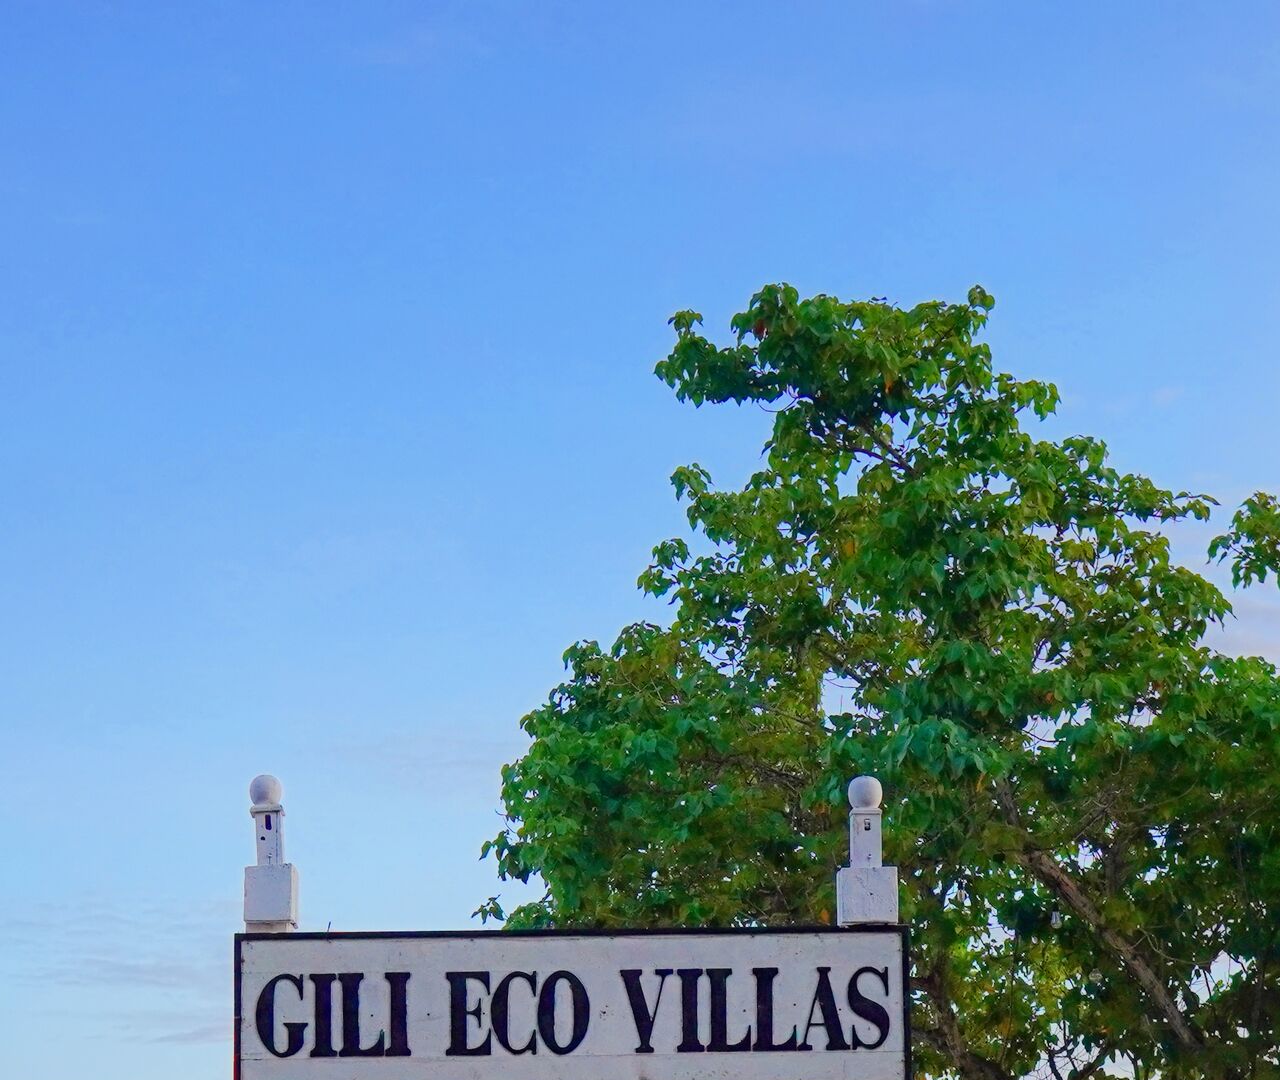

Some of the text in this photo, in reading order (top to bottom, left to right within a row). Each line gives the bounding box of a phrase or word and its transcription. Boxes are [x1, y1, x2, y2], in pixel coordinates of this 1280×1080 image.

[254, 965, 891, 1058] GILI ECO VILLAS
